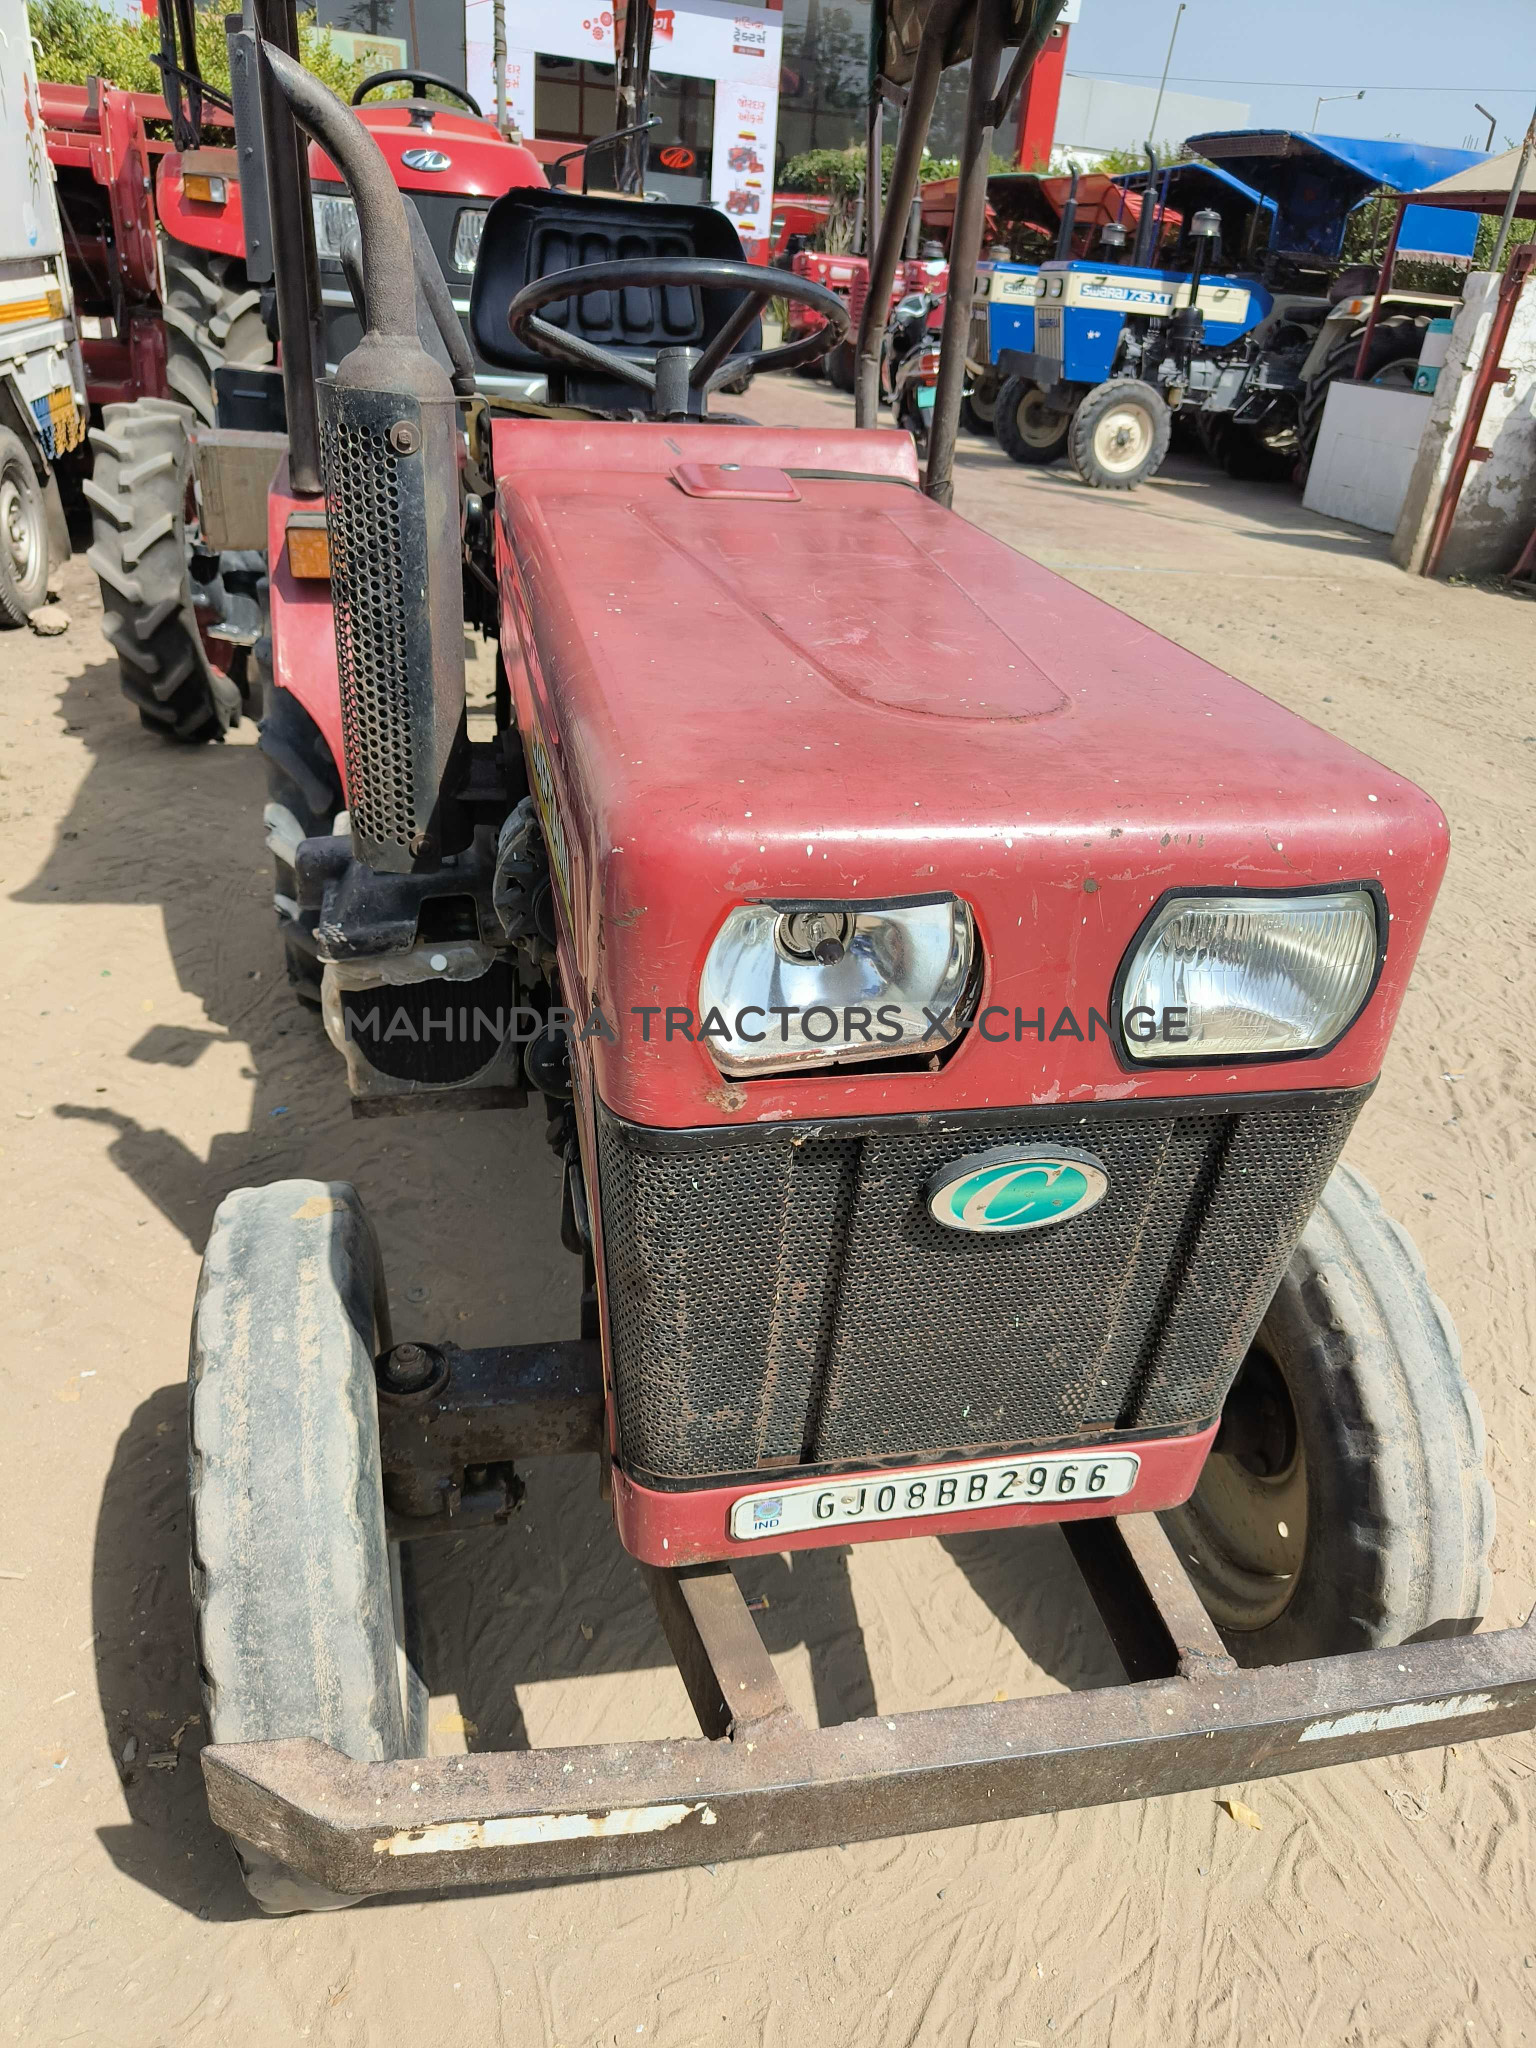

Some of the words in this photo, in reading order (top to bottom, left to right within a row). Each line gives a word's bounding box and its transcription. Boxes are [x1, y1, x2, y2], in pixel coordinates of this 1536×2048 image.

[1129, 289, 1152, 303] 735
[1153, 293, 1173, 305] XT
[815, 1464, 1109, 1519] GJ08BB2966
[754, 1519, 779, 1531] IND
